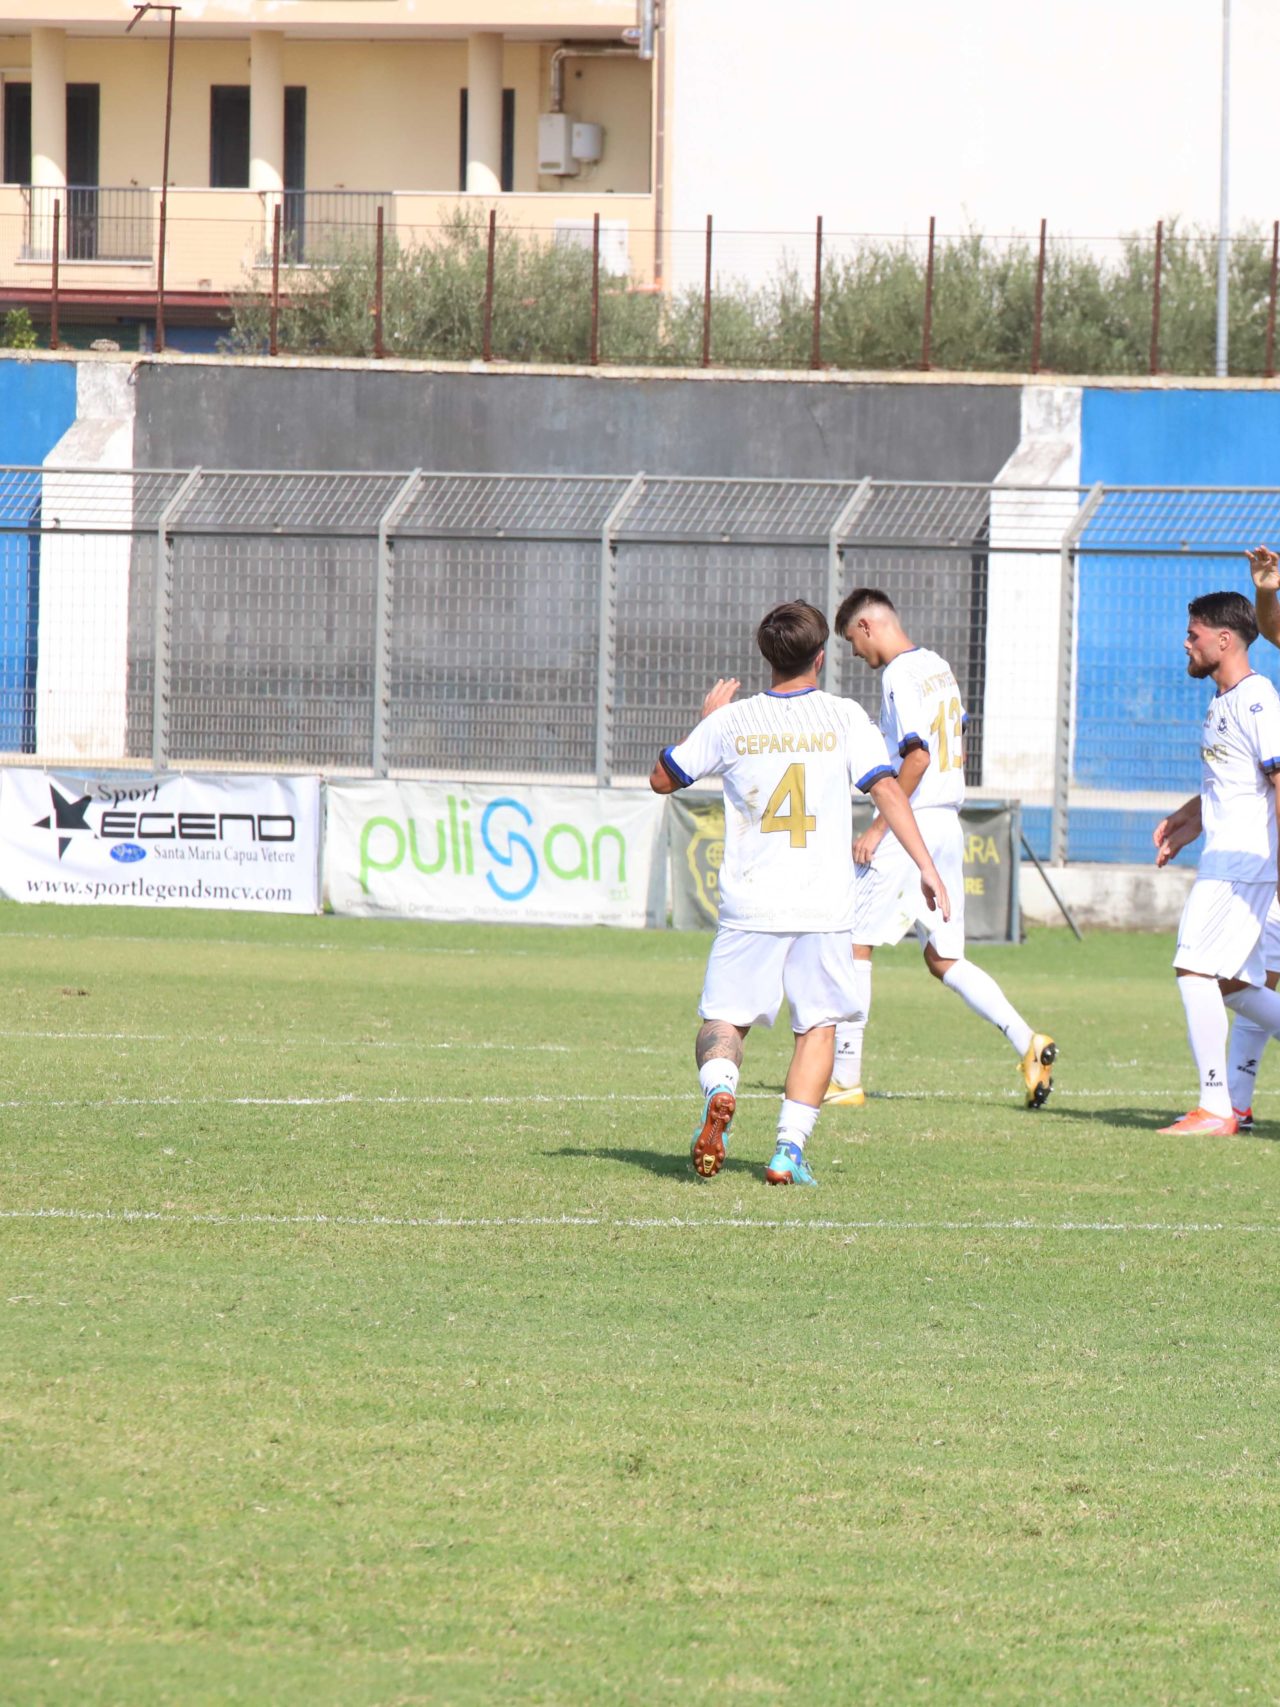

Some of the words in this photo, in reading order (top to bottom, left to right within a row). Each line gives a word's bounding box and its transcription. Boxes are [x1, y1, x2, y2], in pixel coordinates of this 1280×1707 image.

[735, 731, 837, 756] CEPARANO
[98, 784, 159, 809] Sport
[761, 763, 816, 848] 4
[154, 844, 185, 860] Santa
[188, 845, 221, 861] Maria
[224, 847, 257, 866] Capua
[262, 847, 296, 863] Vetere
[27, 878, 293, 902] www.sportlegendsmcv.com
